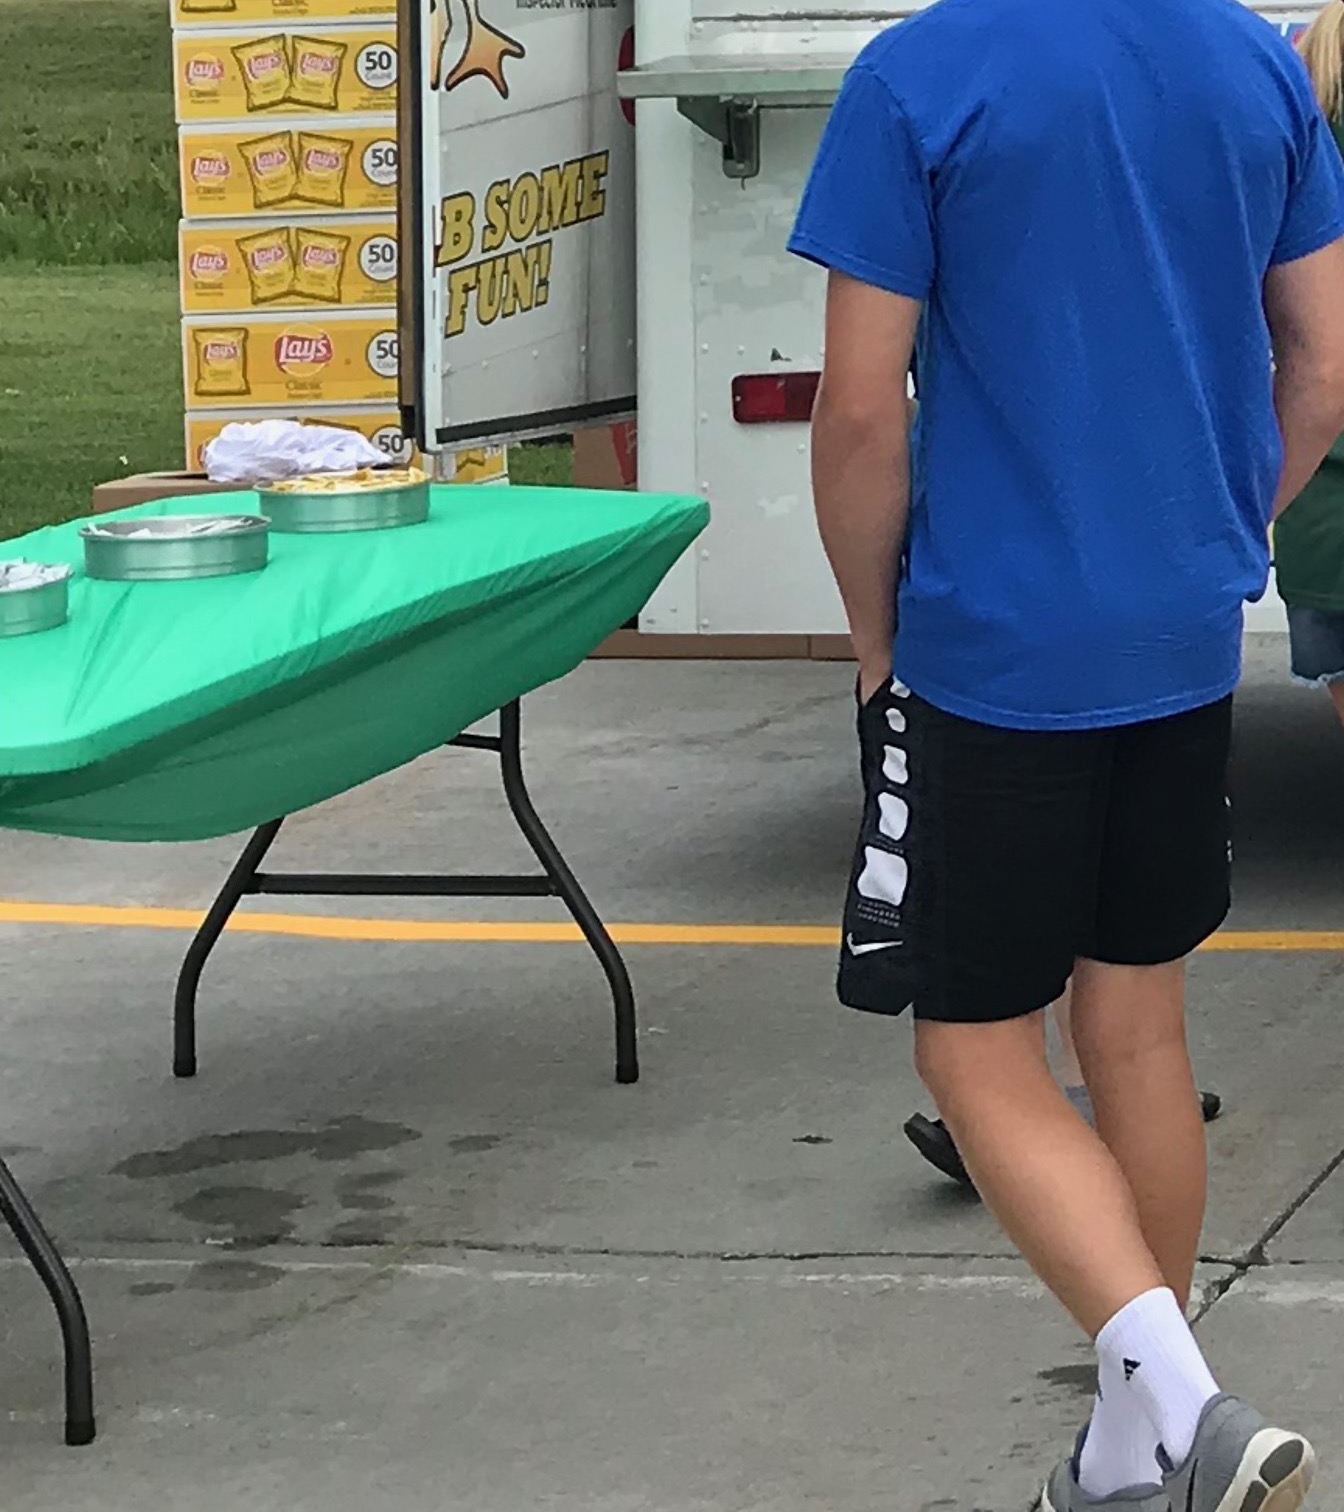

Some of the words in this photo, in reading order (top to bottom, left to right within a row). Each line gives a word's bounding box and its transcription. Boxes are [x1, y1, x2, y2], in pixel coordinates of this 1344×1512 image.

[364, 50, 393, 72] 50
[370, 147, 398, 168] 50
[481, 149, 610, 254] SOME
[367, 243, 395, 264] 50
[444, 238, 553, 339] FUN!
[376, 339, 399, 360] 50
[377, 434, 404, 454] 50
